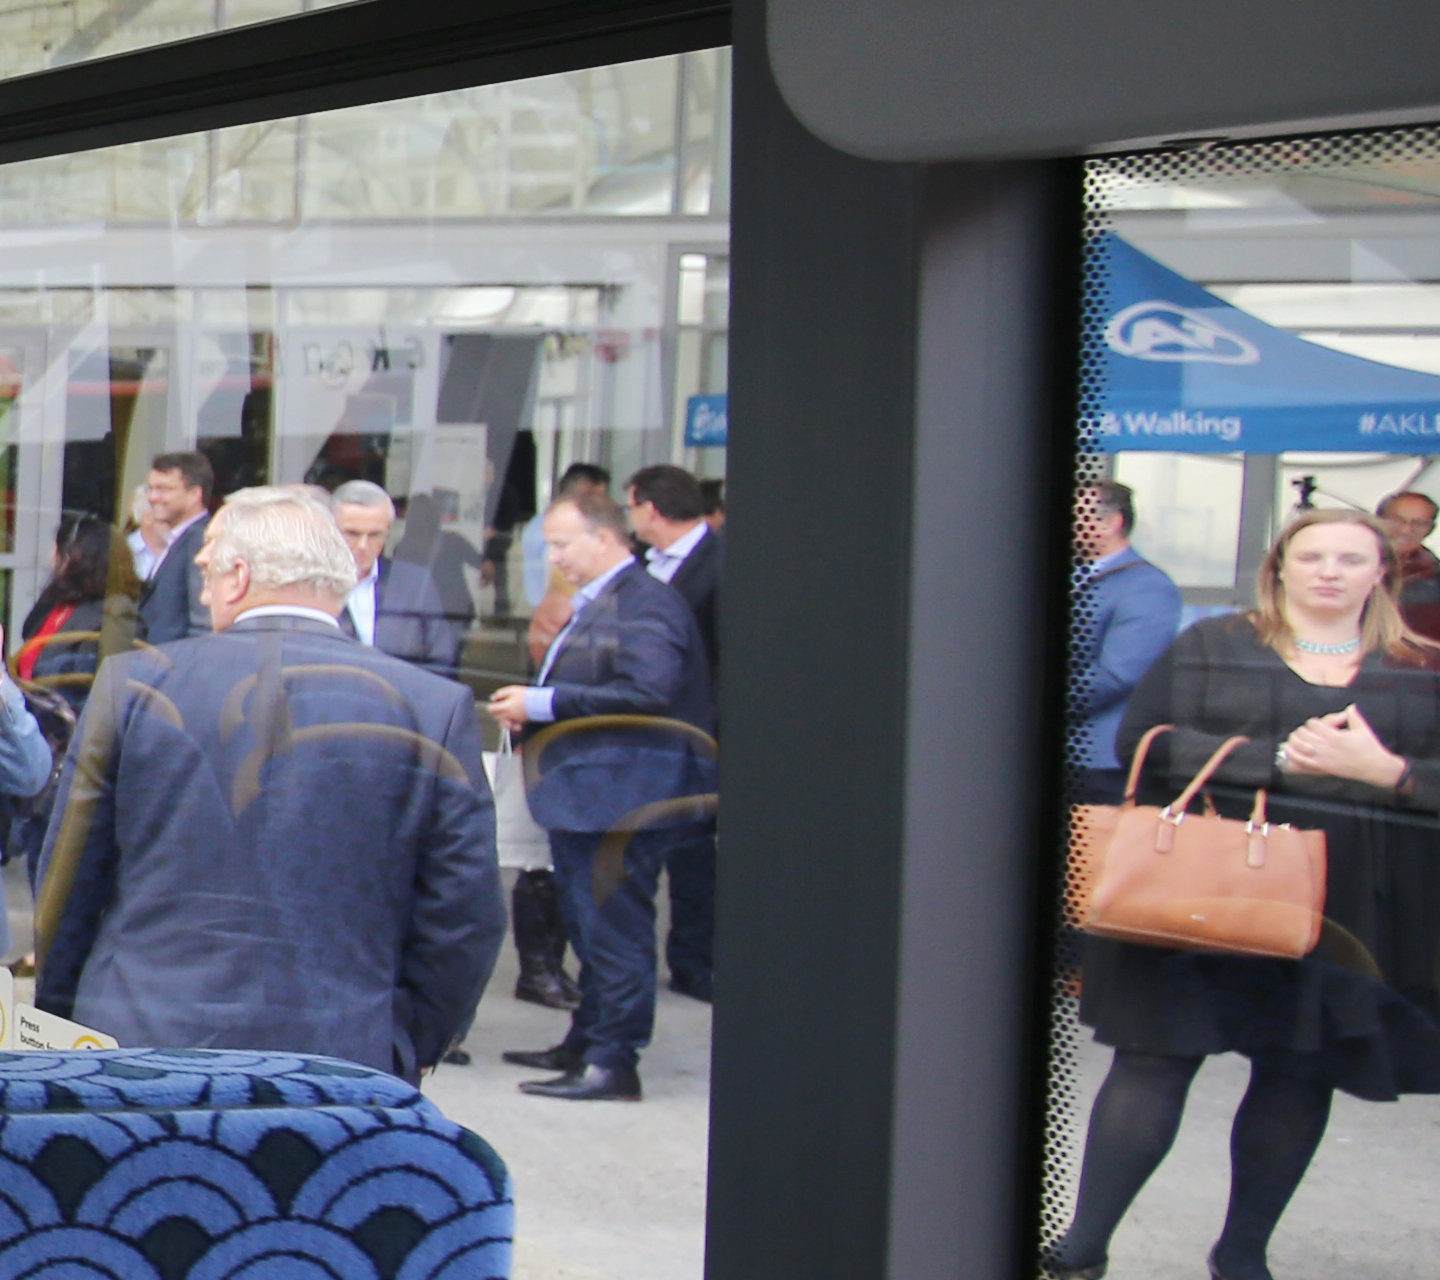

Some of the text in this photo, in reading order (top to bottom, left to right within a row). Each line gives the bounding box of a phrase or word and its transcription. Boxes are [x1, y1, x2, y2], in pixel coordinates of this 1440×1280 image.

[1124, 411, 1241, 441] Walking
[1358, 412, 1440, 436] #AKL
[20, 1016, 40, 1033] Press
[20, 1032, 45, 1050] button
